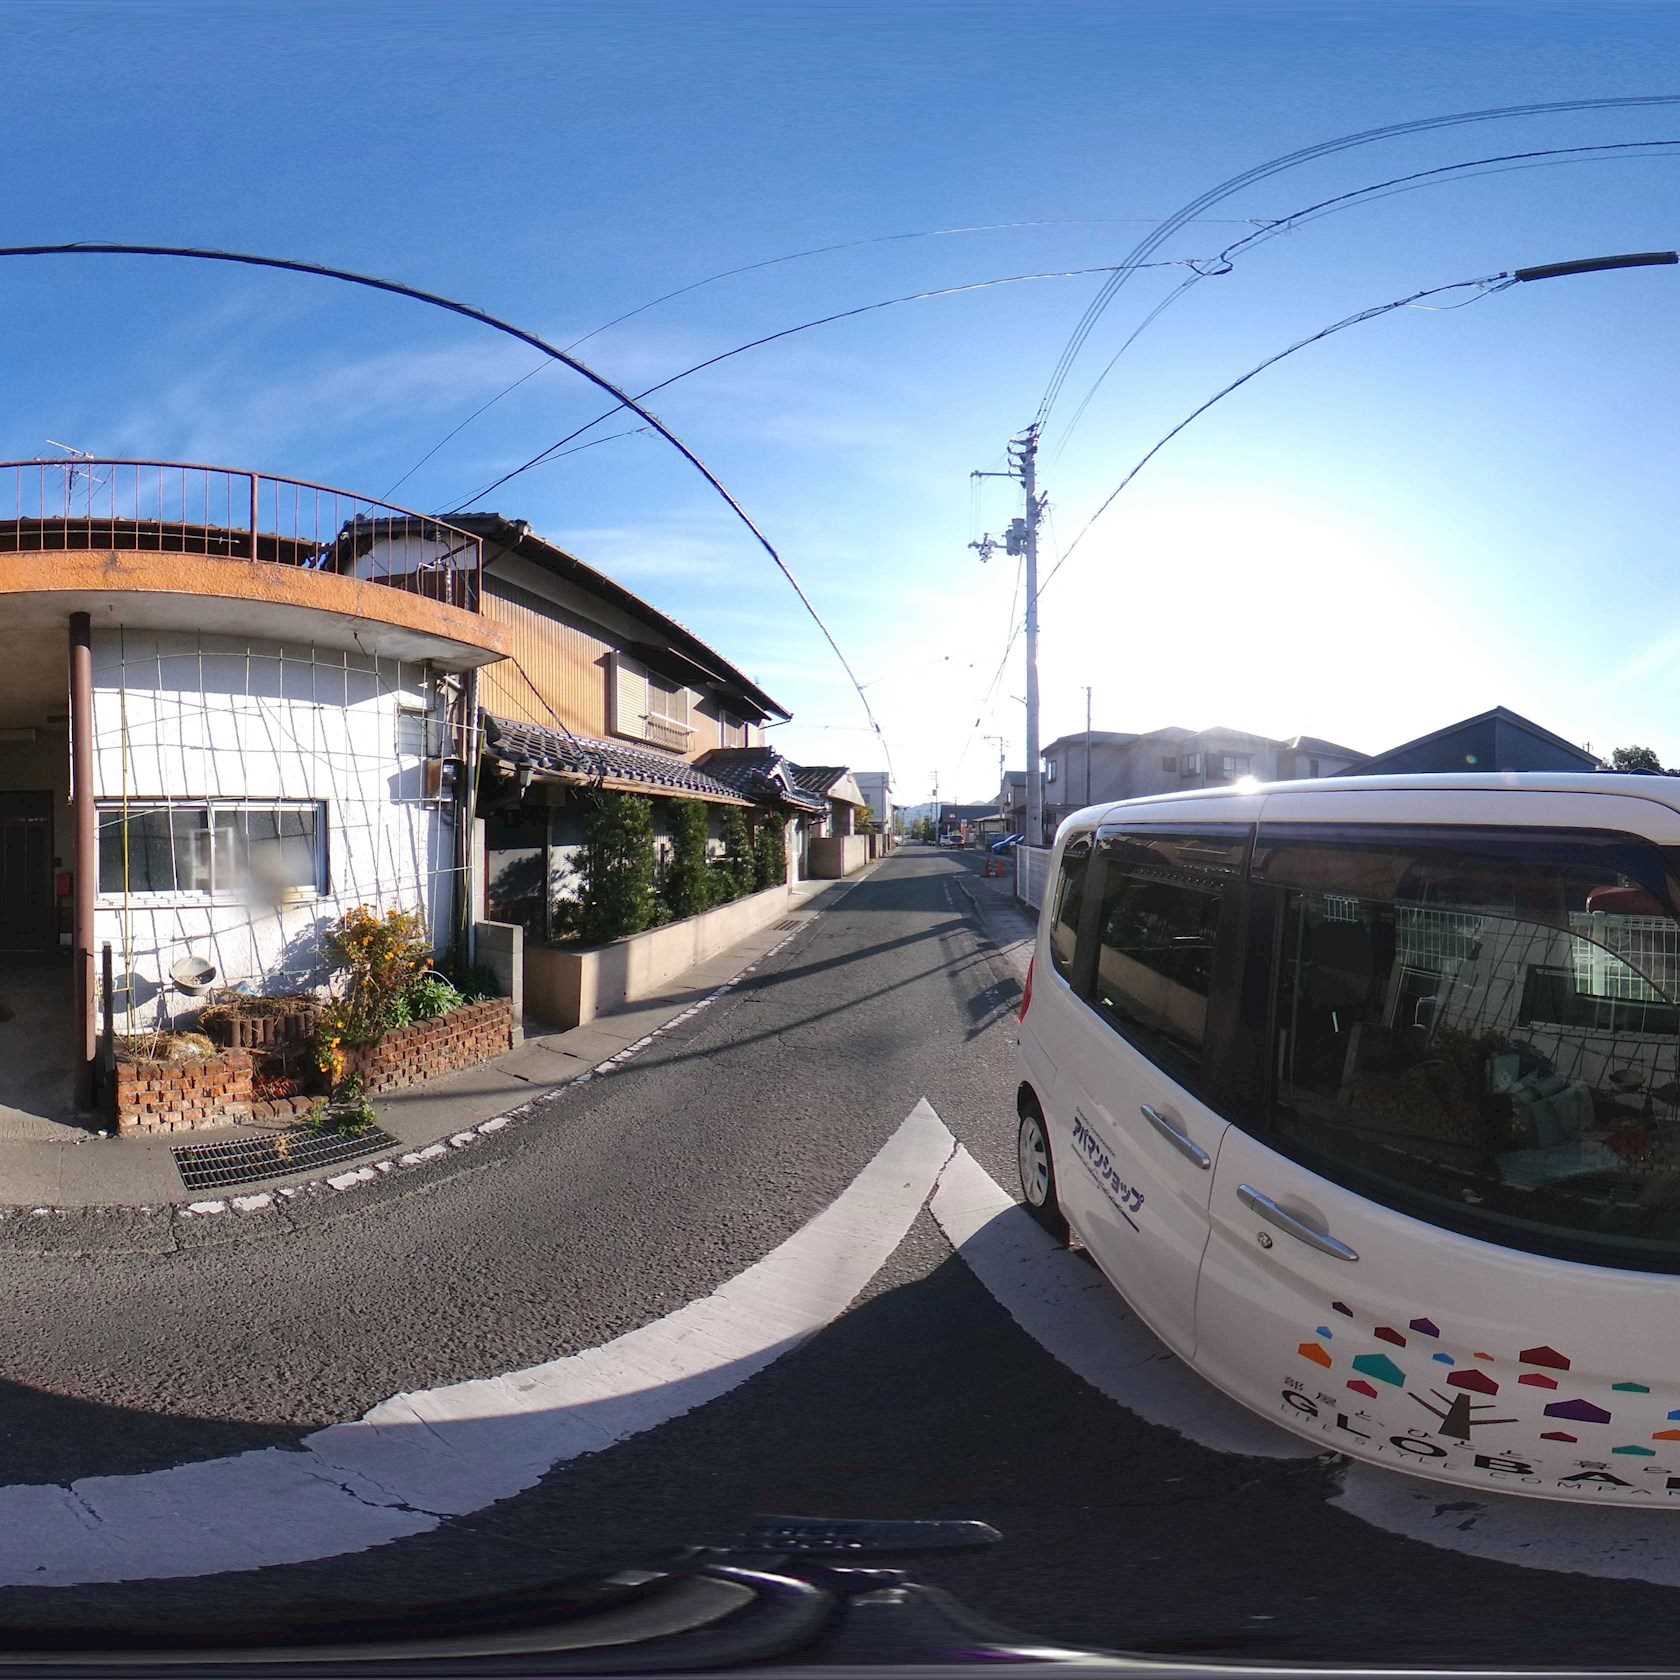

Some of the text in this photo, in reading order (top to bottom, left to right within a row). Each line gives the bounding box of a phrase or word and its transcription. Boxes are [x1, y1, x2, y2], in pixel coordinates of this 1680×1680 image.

[1073, 1116, 1145, 1212] アパマンショップ
